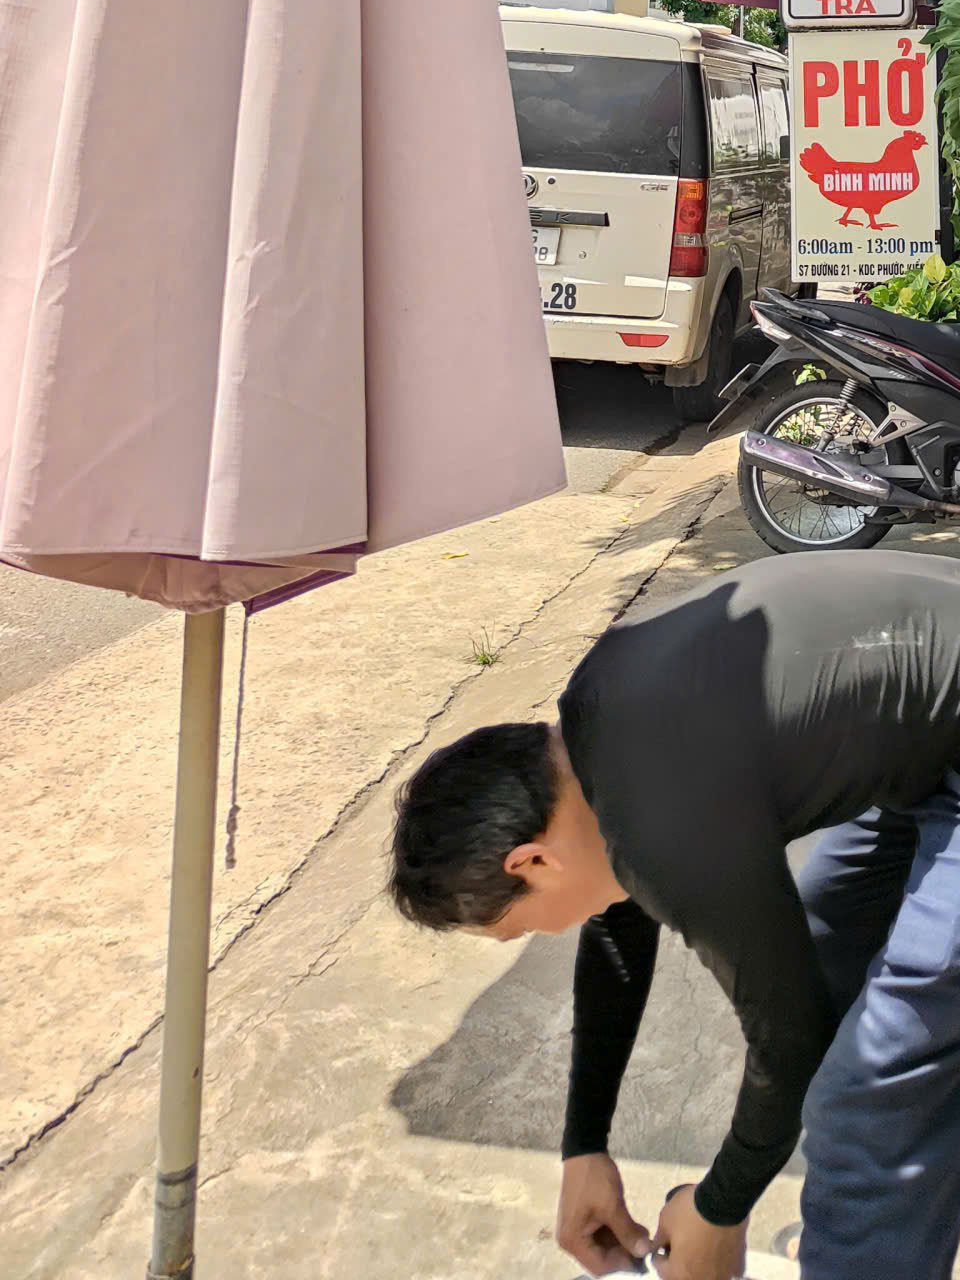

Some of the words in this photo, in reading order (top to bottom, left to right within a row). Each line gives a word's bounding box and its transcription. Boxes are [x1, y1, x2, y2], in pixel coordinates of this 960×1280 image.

[803, 38, 927, 128] PHỞ
[823, 169, 863, 192] BÌNH
[868, 172, 913, 191] MINH
[798, 238, 853, 255] 6:00am
[867, 237, 905, 254] 13:00
[910, 240, 934, 257] pm
[811, 261, 839, 277] ĐƯỜNG
[841, 264, 850, 276] 21
[858, 264, 875, 276] KDC
[877, 261, 904, 276] PHƯỚC
